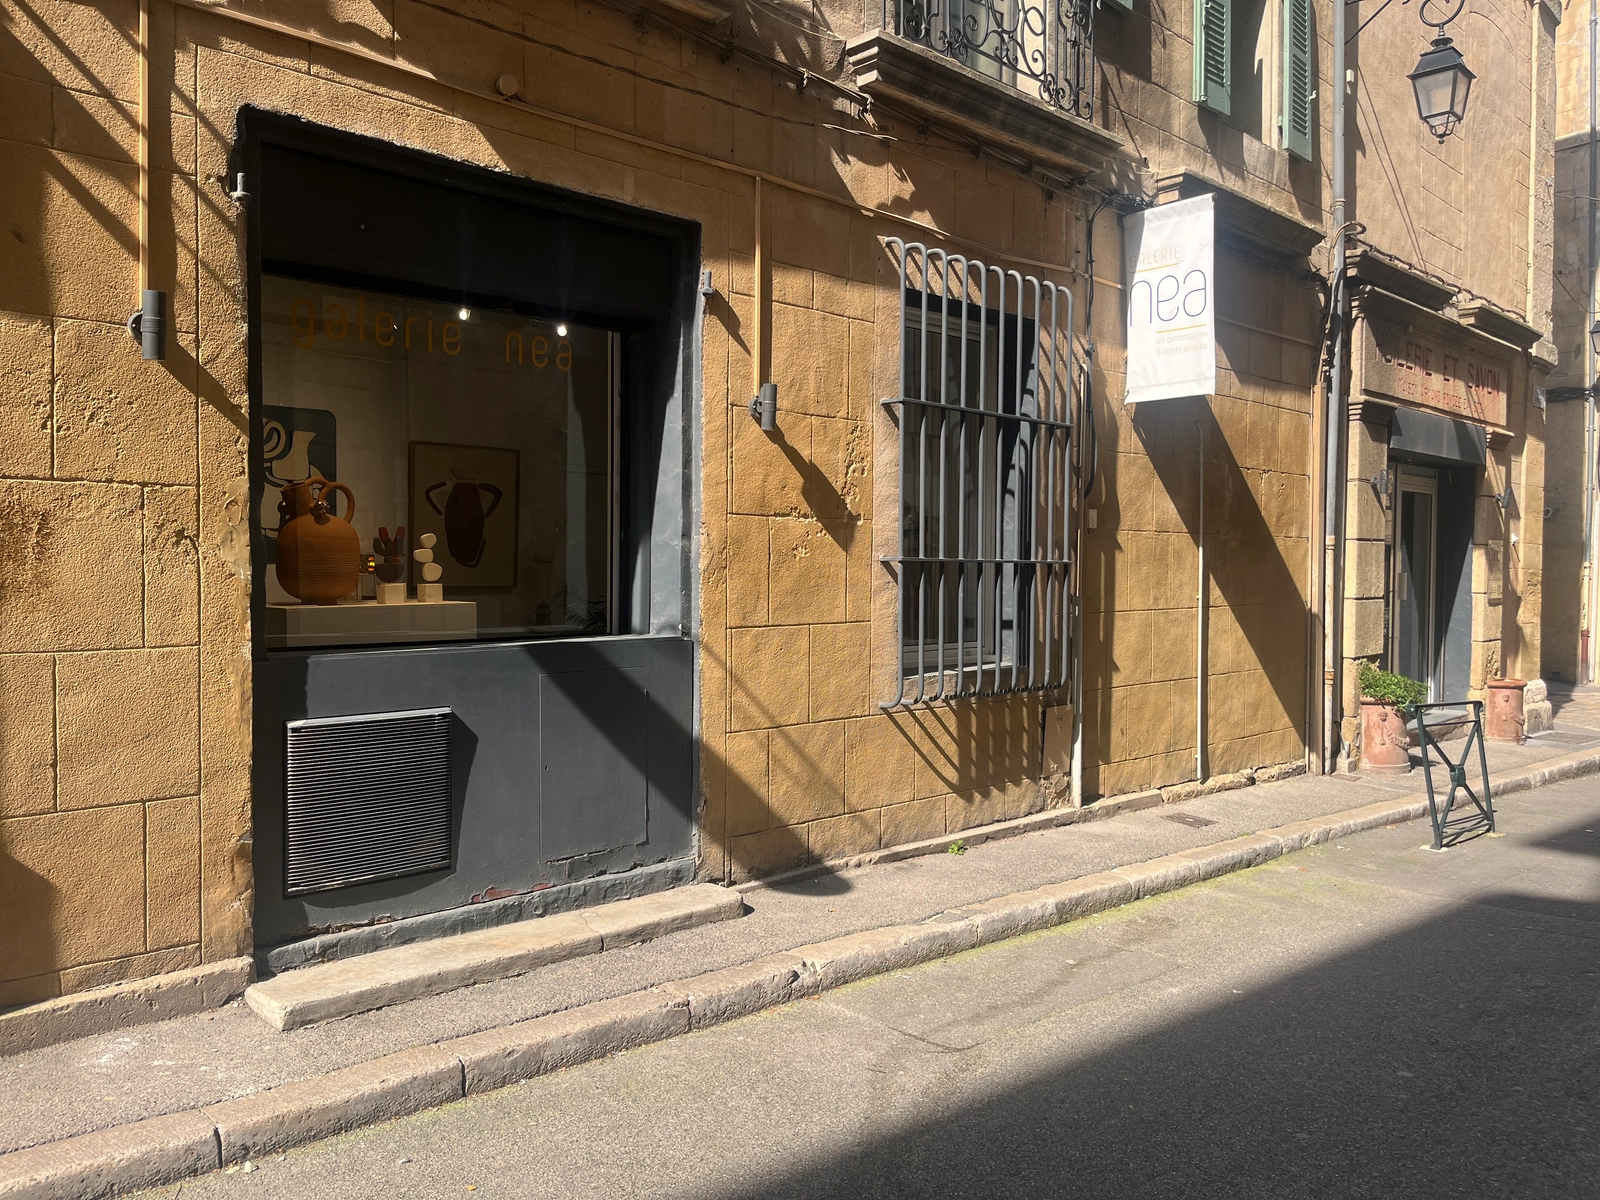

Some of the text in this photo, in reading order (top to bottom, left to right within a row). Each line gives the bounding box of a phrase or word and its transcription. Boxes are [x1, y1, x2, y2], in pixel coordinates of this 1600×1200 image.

[1129, 245, 1180, 269] GALERIE
[1129, 269, 1207, 327] nea
[291, 295, 573, 371] galerie nea
[1156, 330, 1208, 345] art contemporain
[1162, 346, 1182, 356] objets
[1183, 342, 1208, 352] uniques
[1443, 353, 1458, 383] ET
[1467, 362, 1501, 397] SAVON
